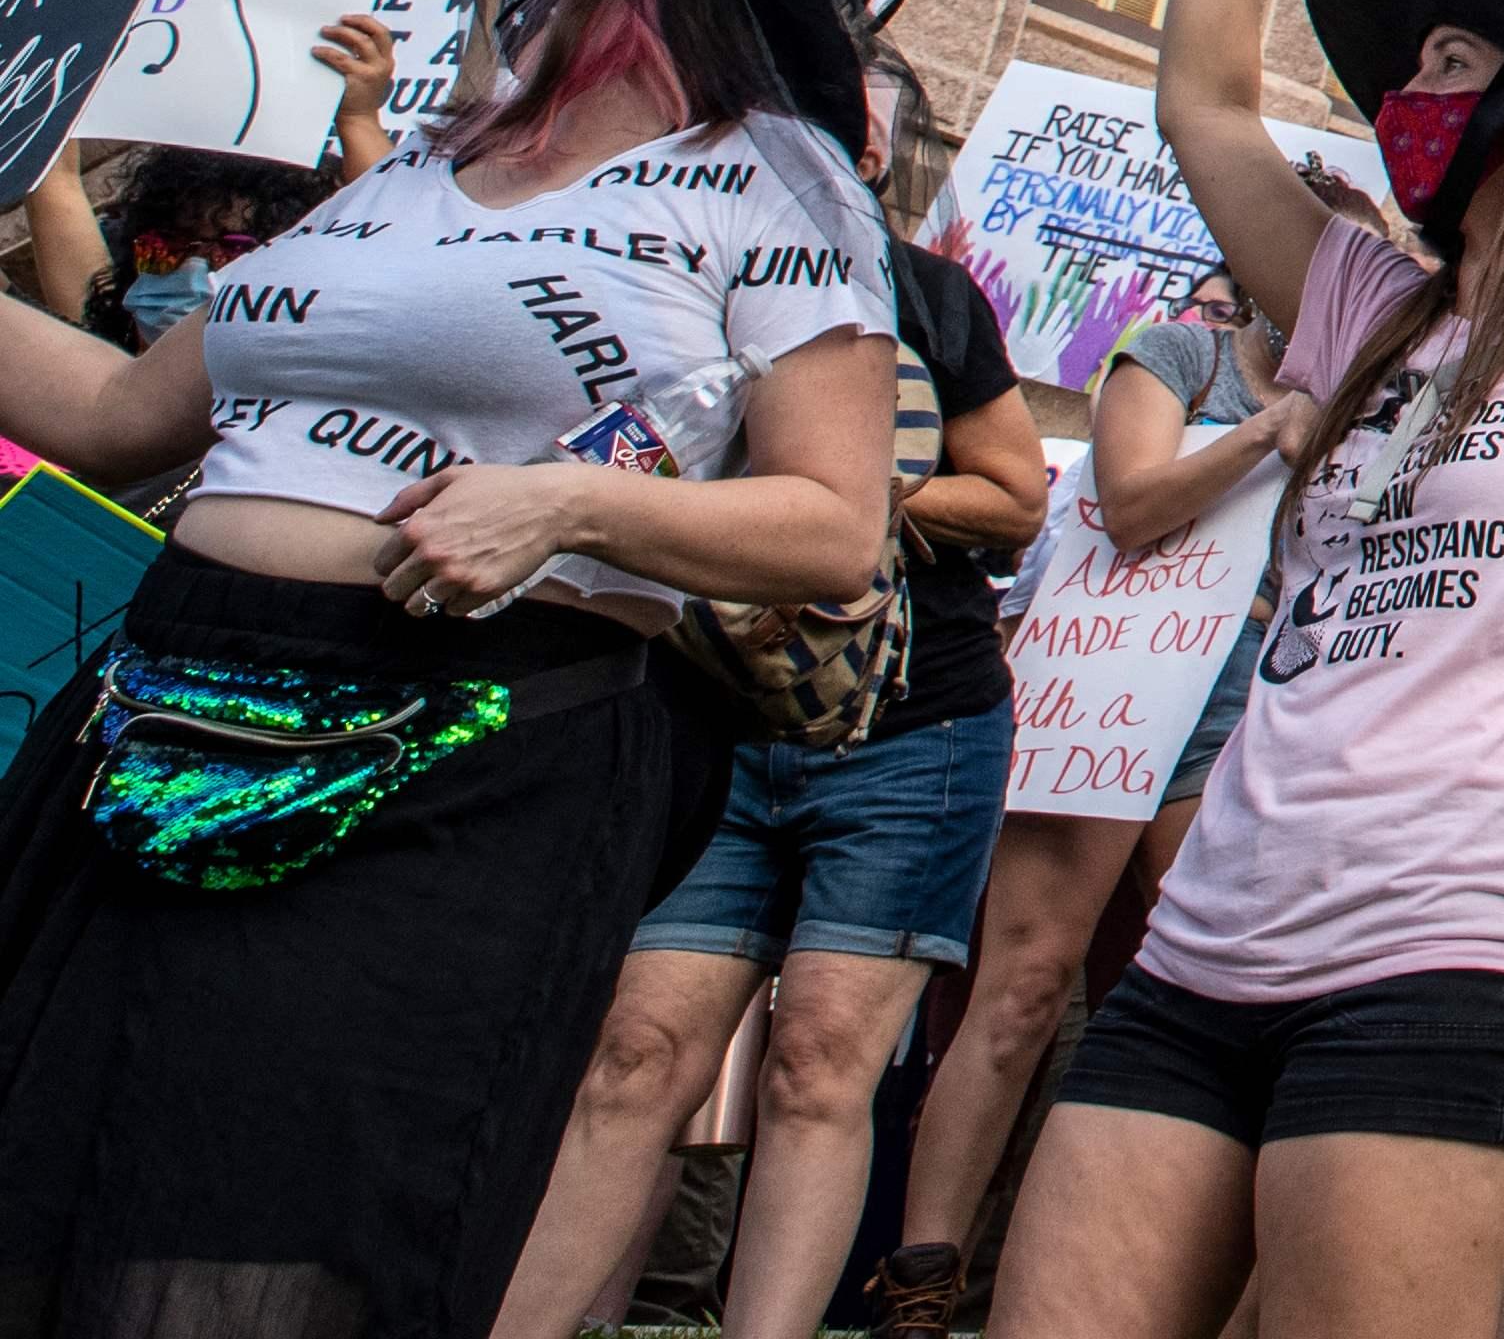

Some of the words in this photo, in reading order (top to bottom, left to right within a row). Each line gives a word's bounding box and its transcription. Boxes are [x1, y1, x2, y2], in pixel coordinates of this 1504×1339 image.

[1043, 105, 1144, 153] RAISE
[993, 130, 1052, 163] IF
[1055, 141, 1113, 182] YOU
[982, 162, 1149, 225] PERSONALLY
[983, 198, 1033, 236] BY
[730, 245, 854, 290] UINN
[1043, 240, 1119, 285] THE
[508, 274, 640, 411] HARL
[308, 408, 477, 479] QUIN
[1364, 481, 1415, 524] AW
[1053, 538, 1232, 598] Abbott
[1345, 569, 1480, 622] BECOMES
[1013, 613, 1140, 659] MADE
[1150, 610, 1237, 657] OUT
[1327, 619, 1404, 666] DUTY.
[1099, 692, 1147, 730] a
[1050, 745, 1156, 798] DOG
